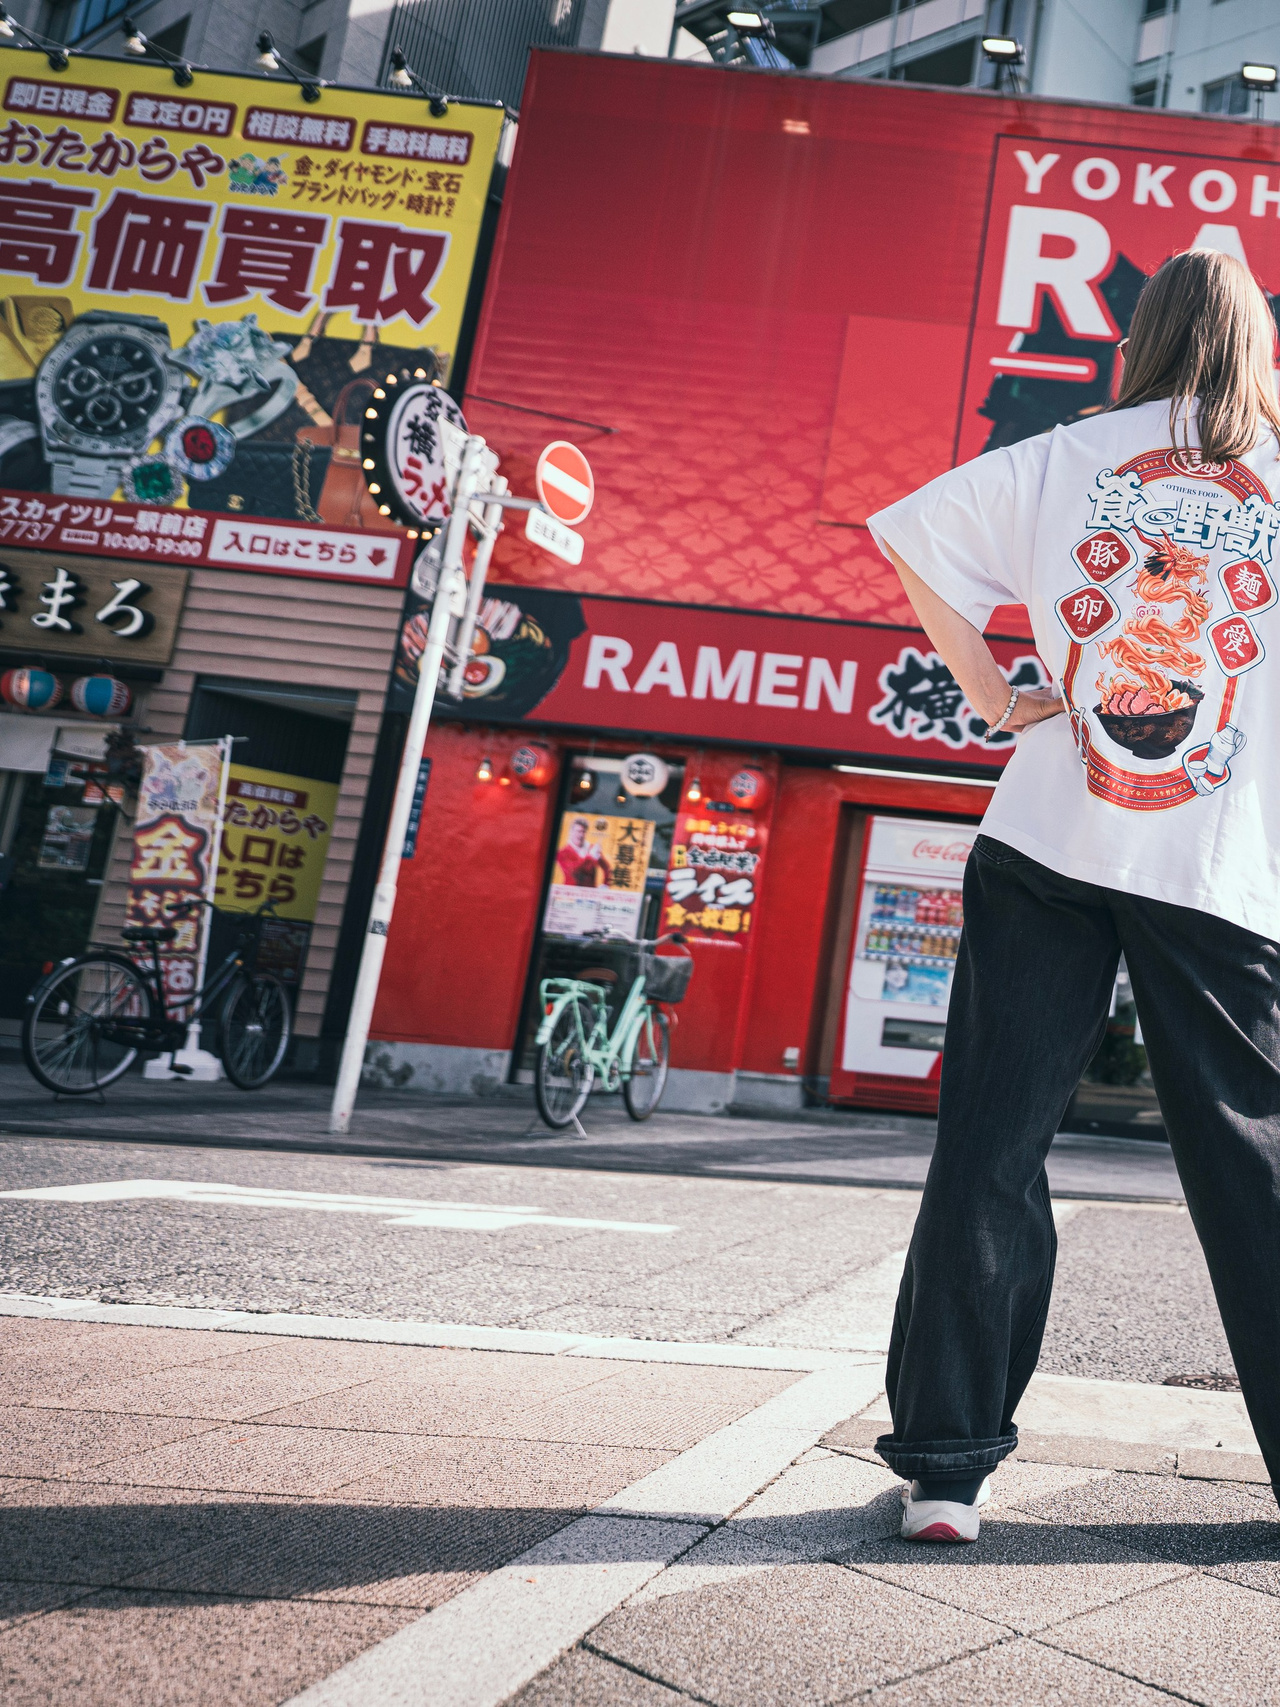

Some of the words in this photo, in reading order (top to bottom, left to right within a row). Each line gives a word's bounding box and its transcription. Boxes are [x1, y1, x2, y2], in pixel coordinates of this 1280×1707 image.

[9, 81, 114, 119] 即日現金
[129, 97, 231, 133] 査定0円
[247, 111, 351, 146] 相談無料
[365, 126, 469, 162] 手数料無料
[0, 119, 226, 189] おたからや
[0, 180, 450, 330] 高価買取
[1165, 483, 1197, 496] OTHERS
[1199, 489, 1219, 499] FOOD
[1, 496, 208, 539] スカイツリー駅前店
[223, 531, 357, 563] 入口はこちら
[1086, 540, 1120, 568] 豚
[0, 567, 145, 637] まろ
[1232, 565, 1262, 602] 麺
[1071, 594, 1105, 625] 卵
[1222, 624, 1250, 658] 愛
[583, 634, 858, 714] RAMEN
[224, 800, 329, 840] たからや
[132, 820, 198, 881] 金
[667, 868, 754, 905] ライス
